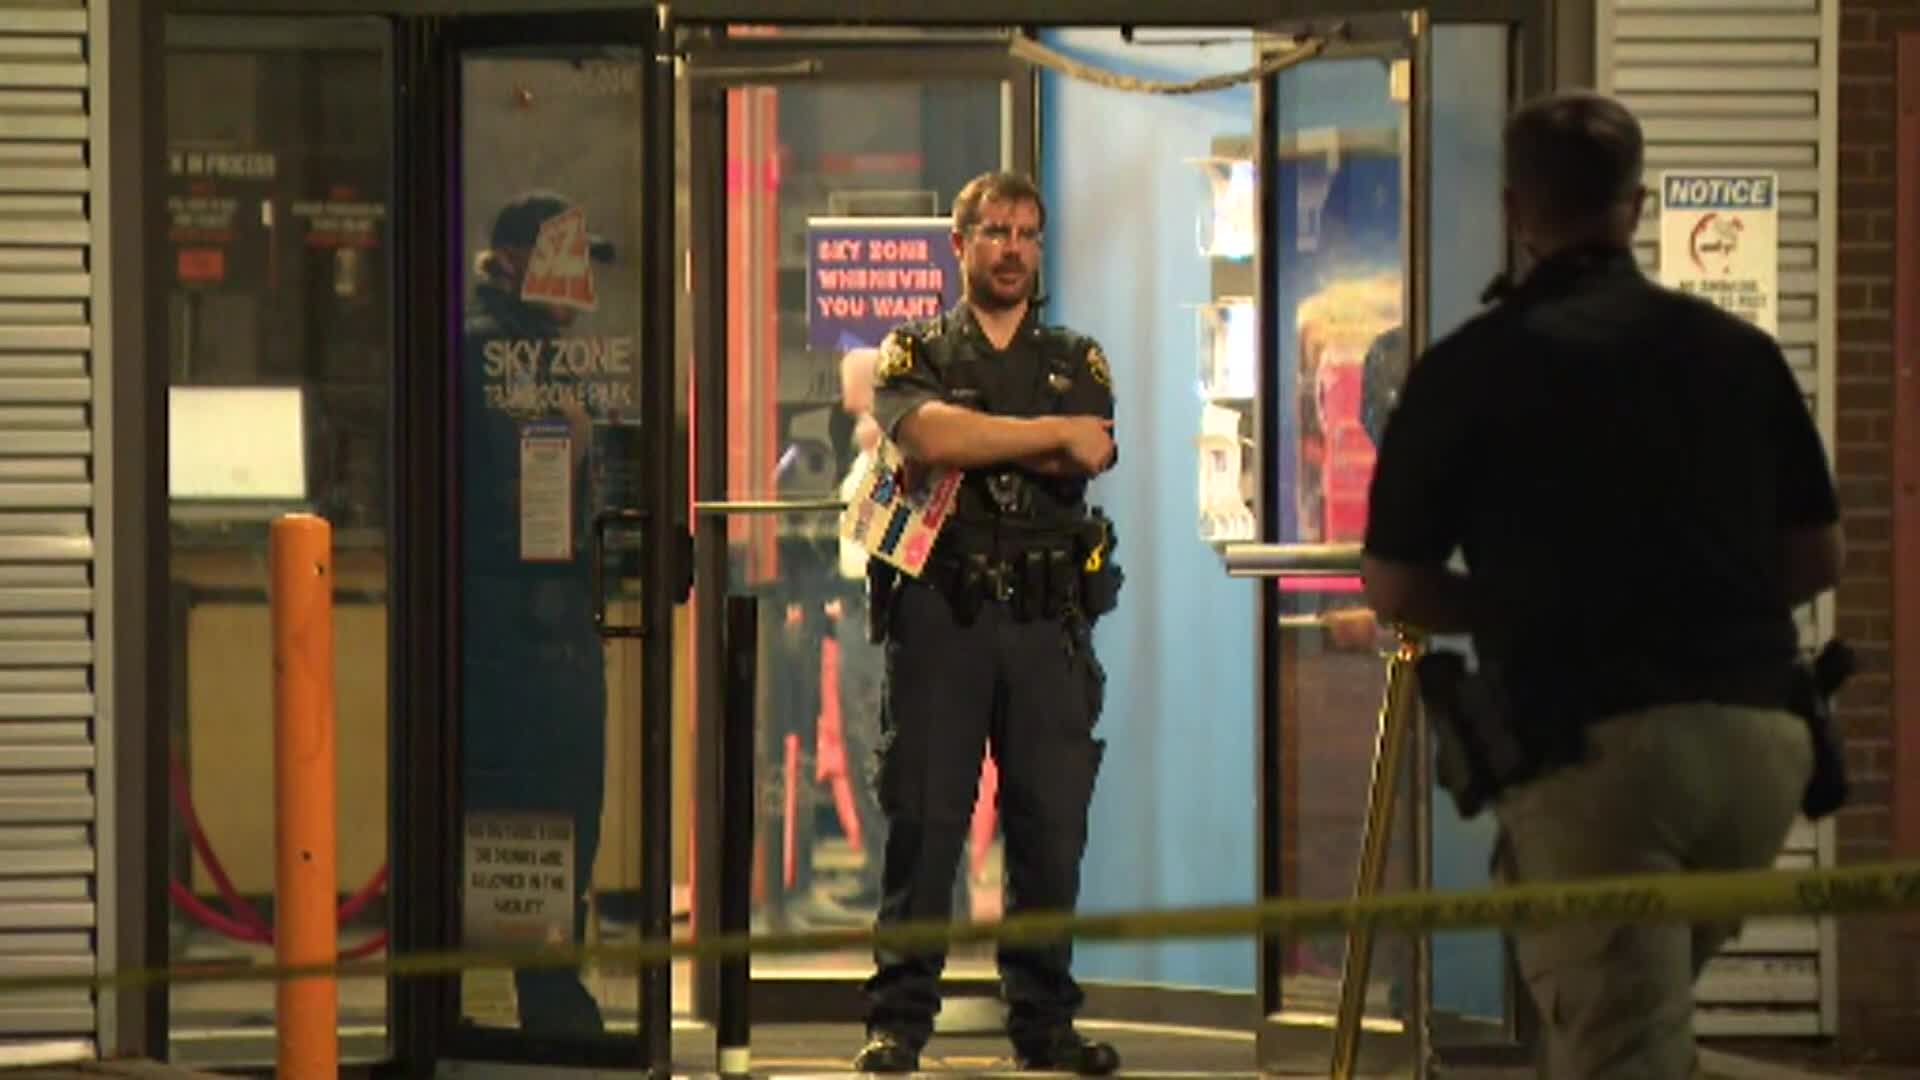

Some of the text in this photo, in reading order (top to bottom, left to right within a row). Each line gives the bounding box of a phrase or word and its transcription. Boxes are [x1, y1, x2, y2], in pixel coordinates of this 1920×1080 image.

[1669, 178, 1769, 205] NOTICE
[818, 240, 928, 261] SKY ZONE
[818, 269, 943, 290] WHENEVER
[818, 296, 938, 318] YOU WANT
[483, 337, 633, 377] SKY ZONE
